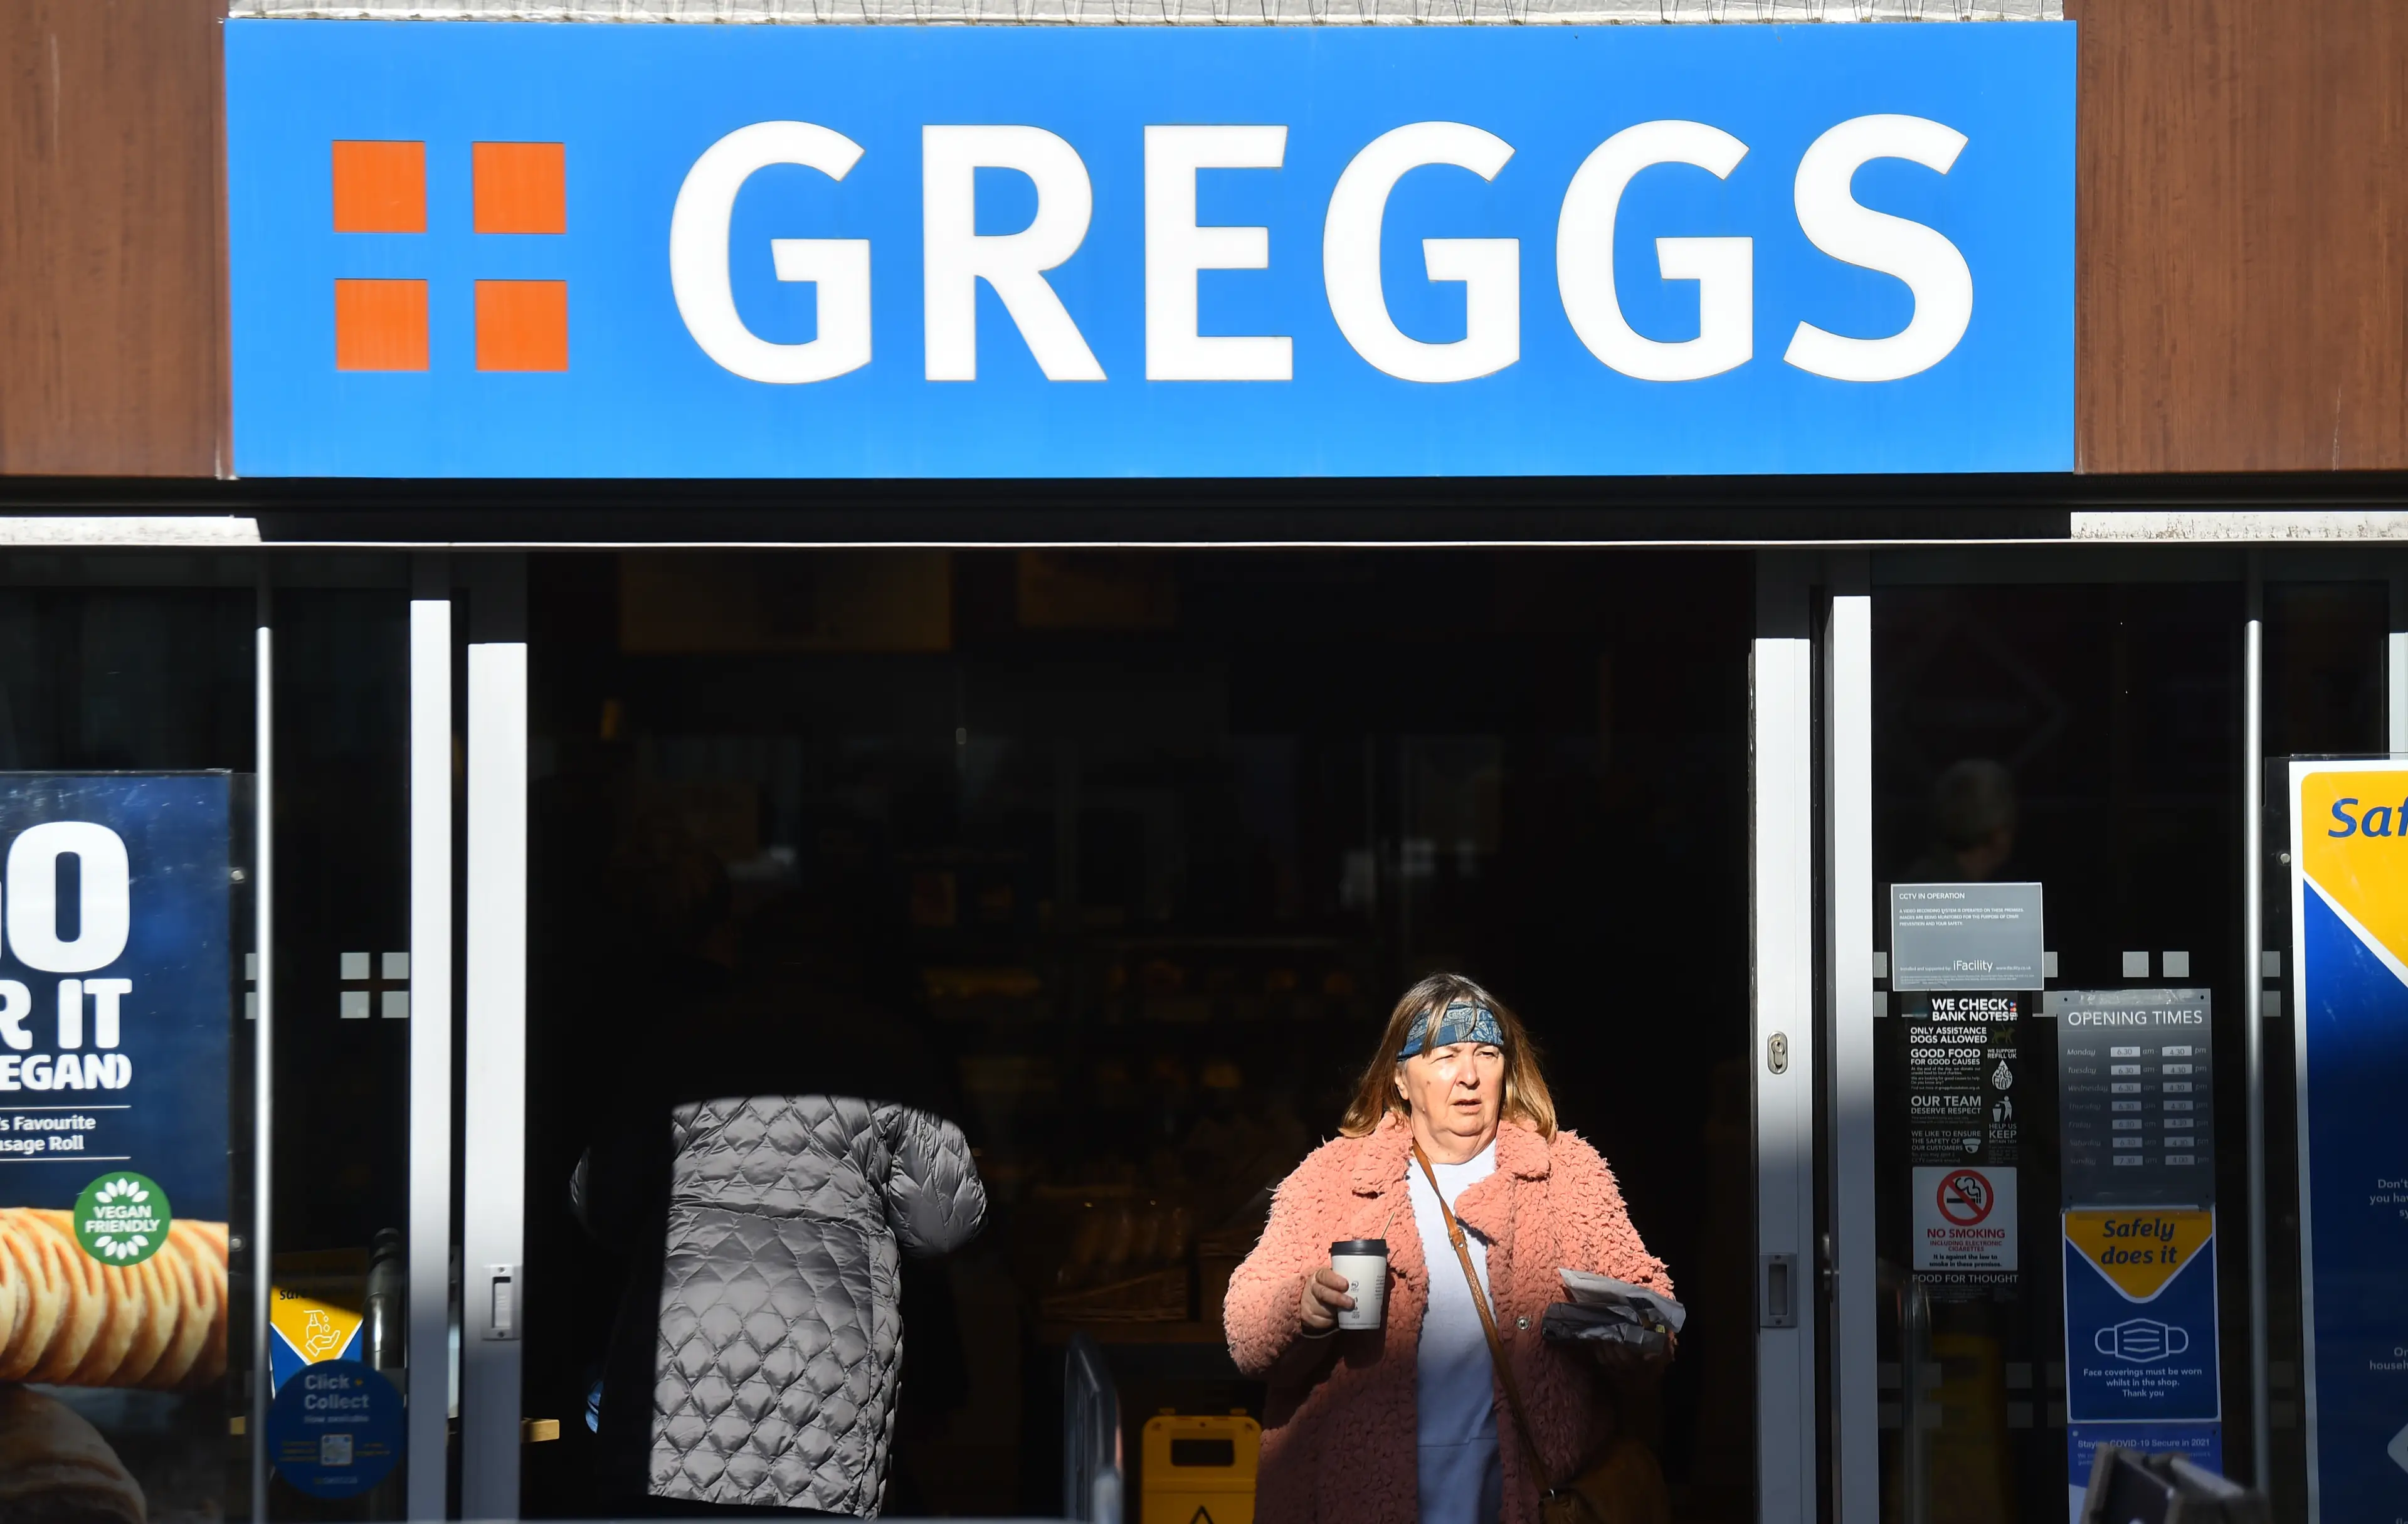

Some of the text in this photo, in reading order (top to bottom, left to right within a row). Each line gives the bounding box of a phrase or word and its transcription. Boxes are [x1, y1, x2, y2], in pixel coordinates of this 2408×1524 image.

[669, 113, 1973, 384] GREGGS
[0, 821, 130, 972] O
[1953, 960, 1993, 973] iFacility
[1931, 998, 2008, 1010] WE CHECK
[58, 978, 133, 1050] IT
[1932, 1011, 1967, 1021] BANK
[2068, 1010, 2202, 1025] OPENING TIMES
[1910, 1035, 1987, 1044] DOGS ALLOWED
[1910, 1049, 1980, 1058] GOOD FOOD
[1911, 1096, 1981, 1106] OUR TEAM
[13, 1114, 97, 1131] Favourite
[1989, 1130, 2017, 1139] KEEP
[48, 1134, 85, 1151] Roll
[2378, 1178, 2408, 1189] Don't
[2369, 1195, 2390, 1205] you
[92, 1205, 152, 1219] VEGAN
[84, 1219, 161, 1234] FRIENDLY
[2102, 1218, 2175, 1242] Safely
[1928, 1229, 2005, 1238] NO SMOKING
[2101, 1246, 2178, 1264] does it
[1913, 1274, 2019, 1283] FOOD FOR THOUGHT
[2104, 1368, 2143, 1377] coverings
[304, 1373, 350, 1390] Click
[2148, 1390, 2164, 1399] you
[304, 1394, 369, 1410] Collect
[2110, 1439, 2150, 1447] COVID-19
